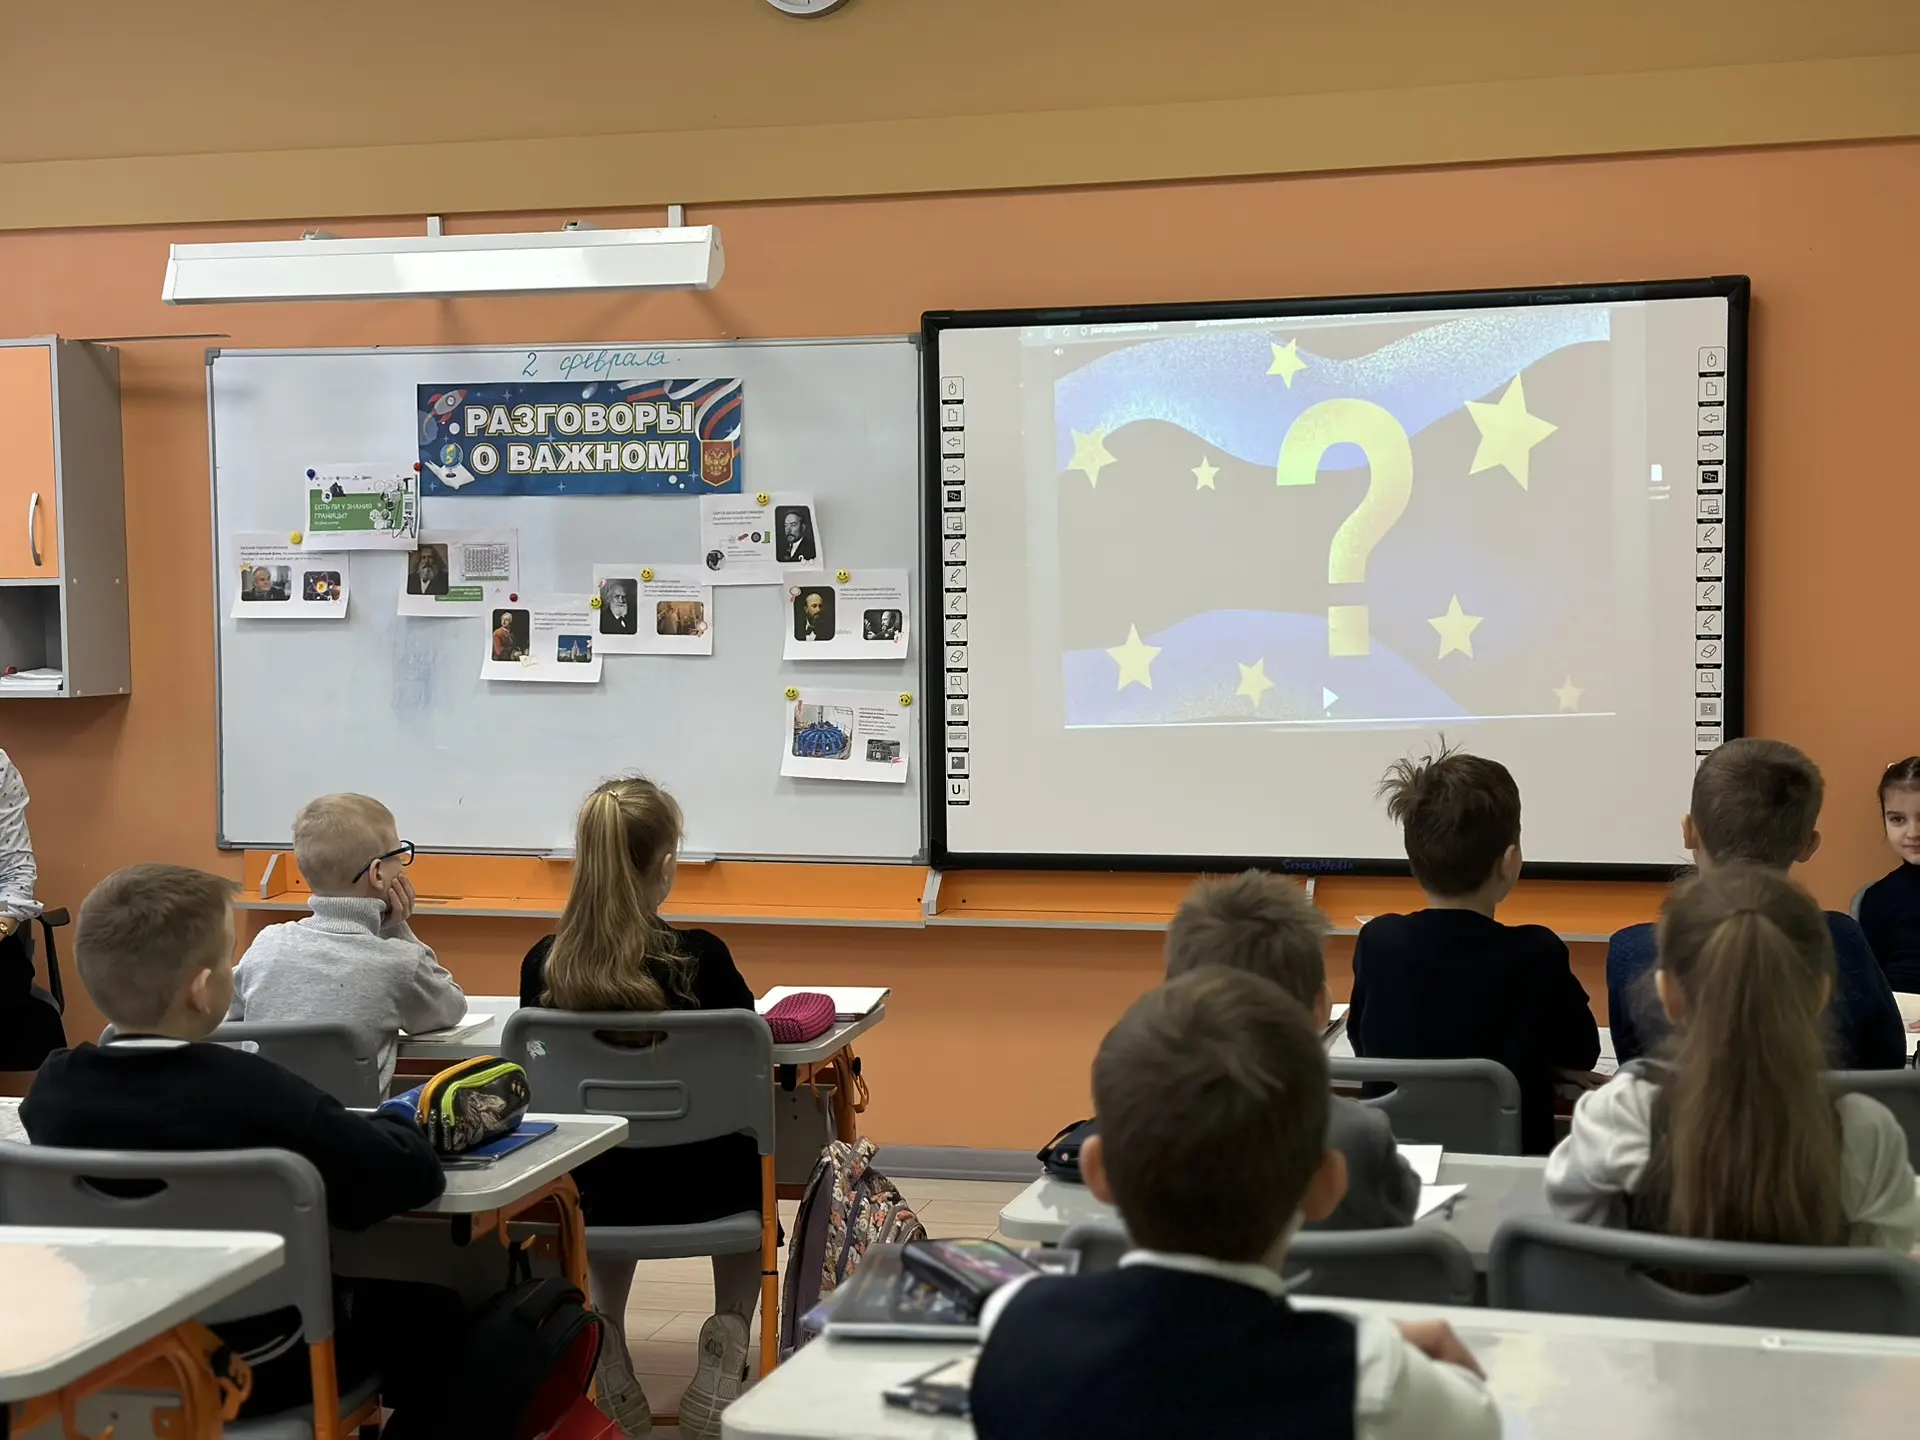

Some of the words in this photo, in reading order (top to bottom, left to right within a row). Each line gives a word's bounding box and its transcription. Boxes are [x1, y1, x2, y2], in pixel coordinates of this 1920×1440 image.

[522, 352, 538, 377] 2
[465, 401, 695, 436] РАЗГОВОРЫ
[470, 442, 499, 474] О
[507, 440, 690, 473] ВАЖНОМ!
[314, 503, 330, 511] ЕСТЬ
[331, 503, 341, 511] ЛИ
[346, 503, 373, 511] ЗНАНИЯ
[314, 511, 348, 520] ГРАНИЦЫ?
